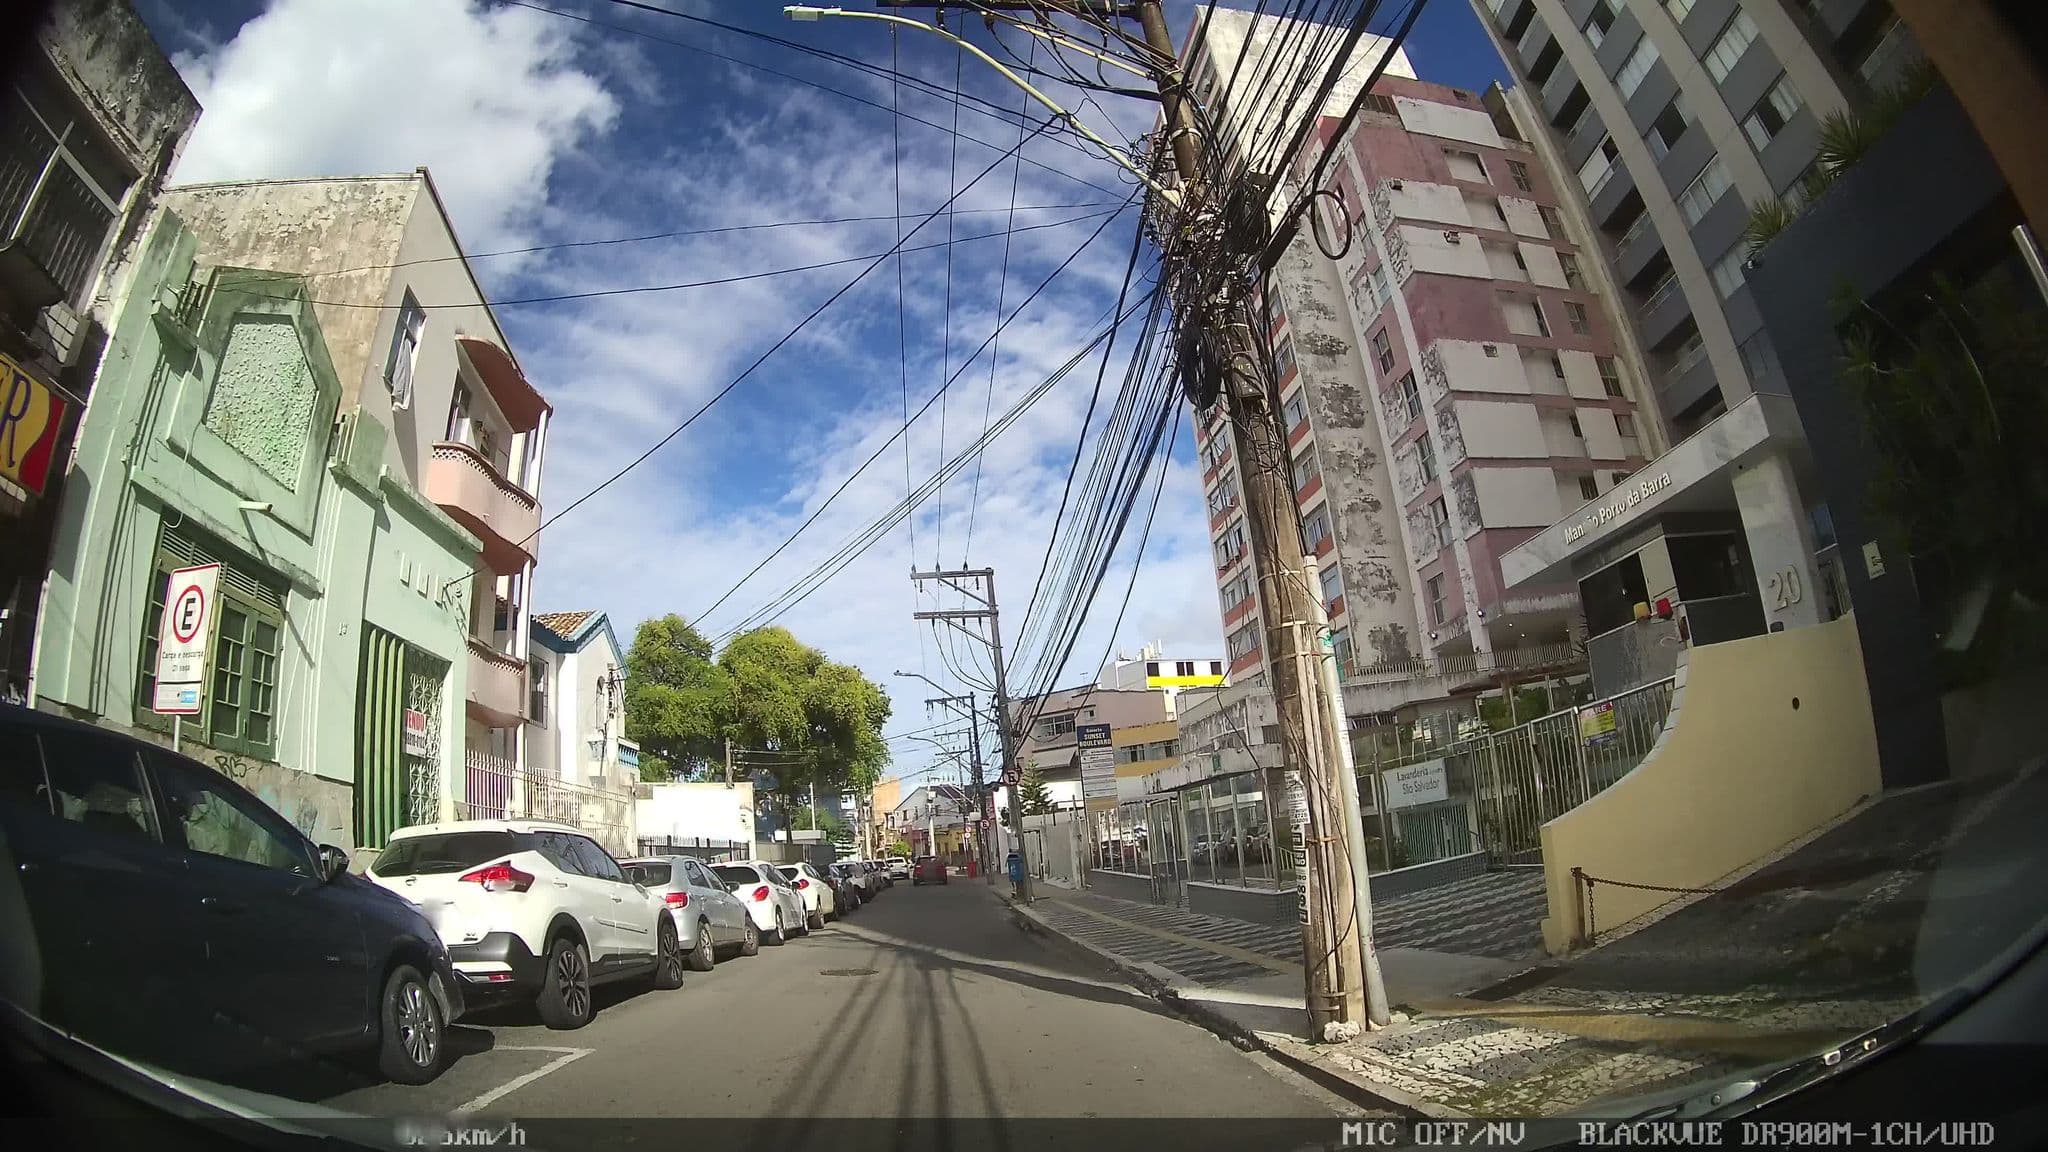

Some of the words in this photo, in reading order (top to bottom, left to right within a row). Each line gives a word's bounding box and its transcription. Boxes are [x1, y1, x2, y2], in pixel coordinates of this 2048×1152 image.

[1627, 489, 1641, 507] da
[1642, 473, 1671, 498] Barra
[1767, 564, 1802, 612] 20
[181, 597, 197, 631] E
[1080, 739, 1112, 747] BOULEVARD
[1084, 733, 1105, 741] SUNSET
[1396, 767, 1429, 782] Lavanderia
[1414, 778, 1440, 793] Salvador
